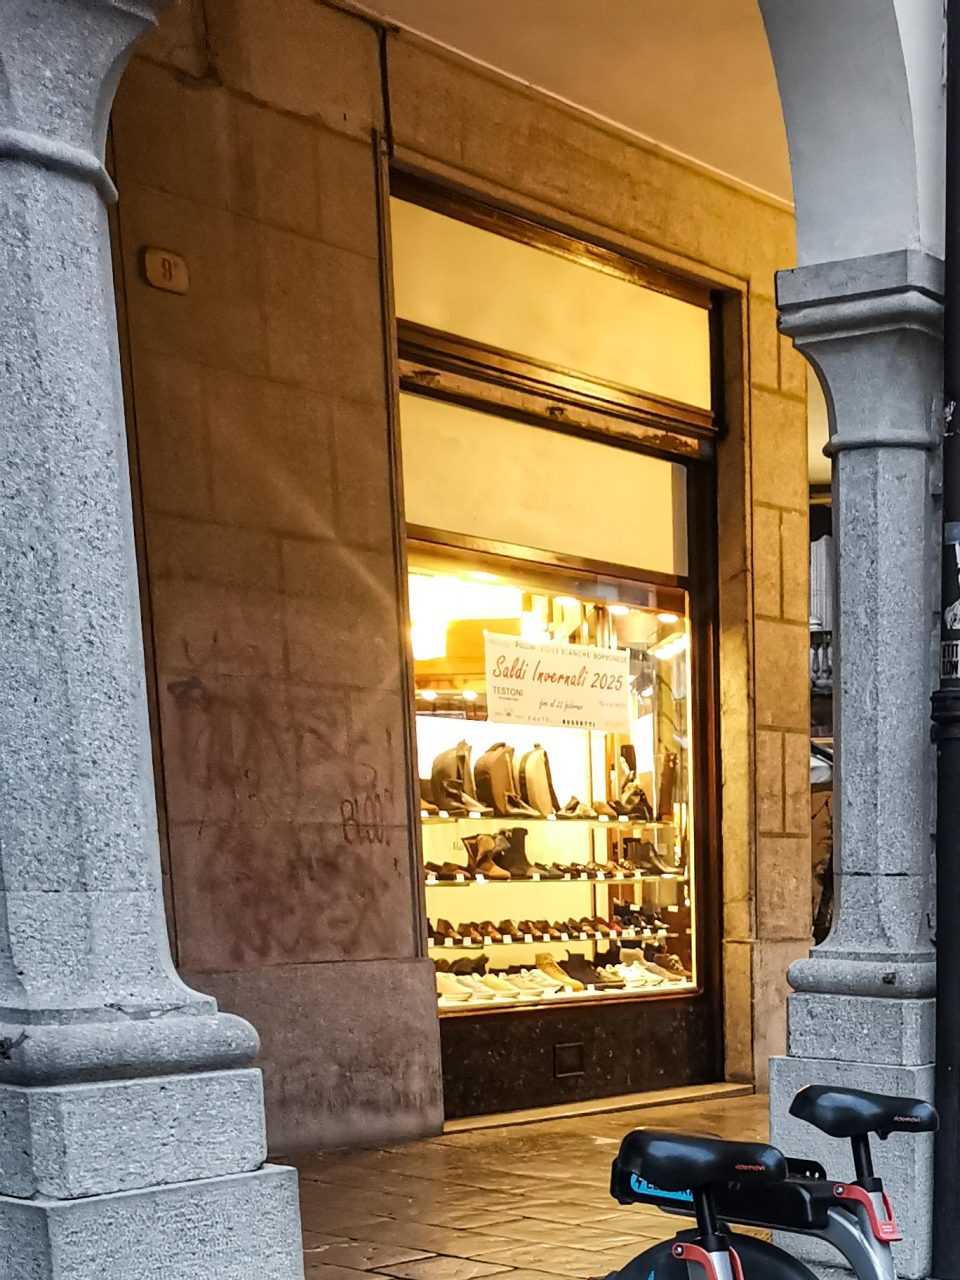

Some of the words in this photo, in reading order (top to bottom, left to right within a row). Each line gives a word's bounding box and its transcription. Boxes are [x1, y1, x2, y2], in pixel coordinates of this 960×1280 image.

[492, 655, 529, 680] Saldi
[532, 660, 588, 687] Invernali
[590, 672, 623, 691] 2025
